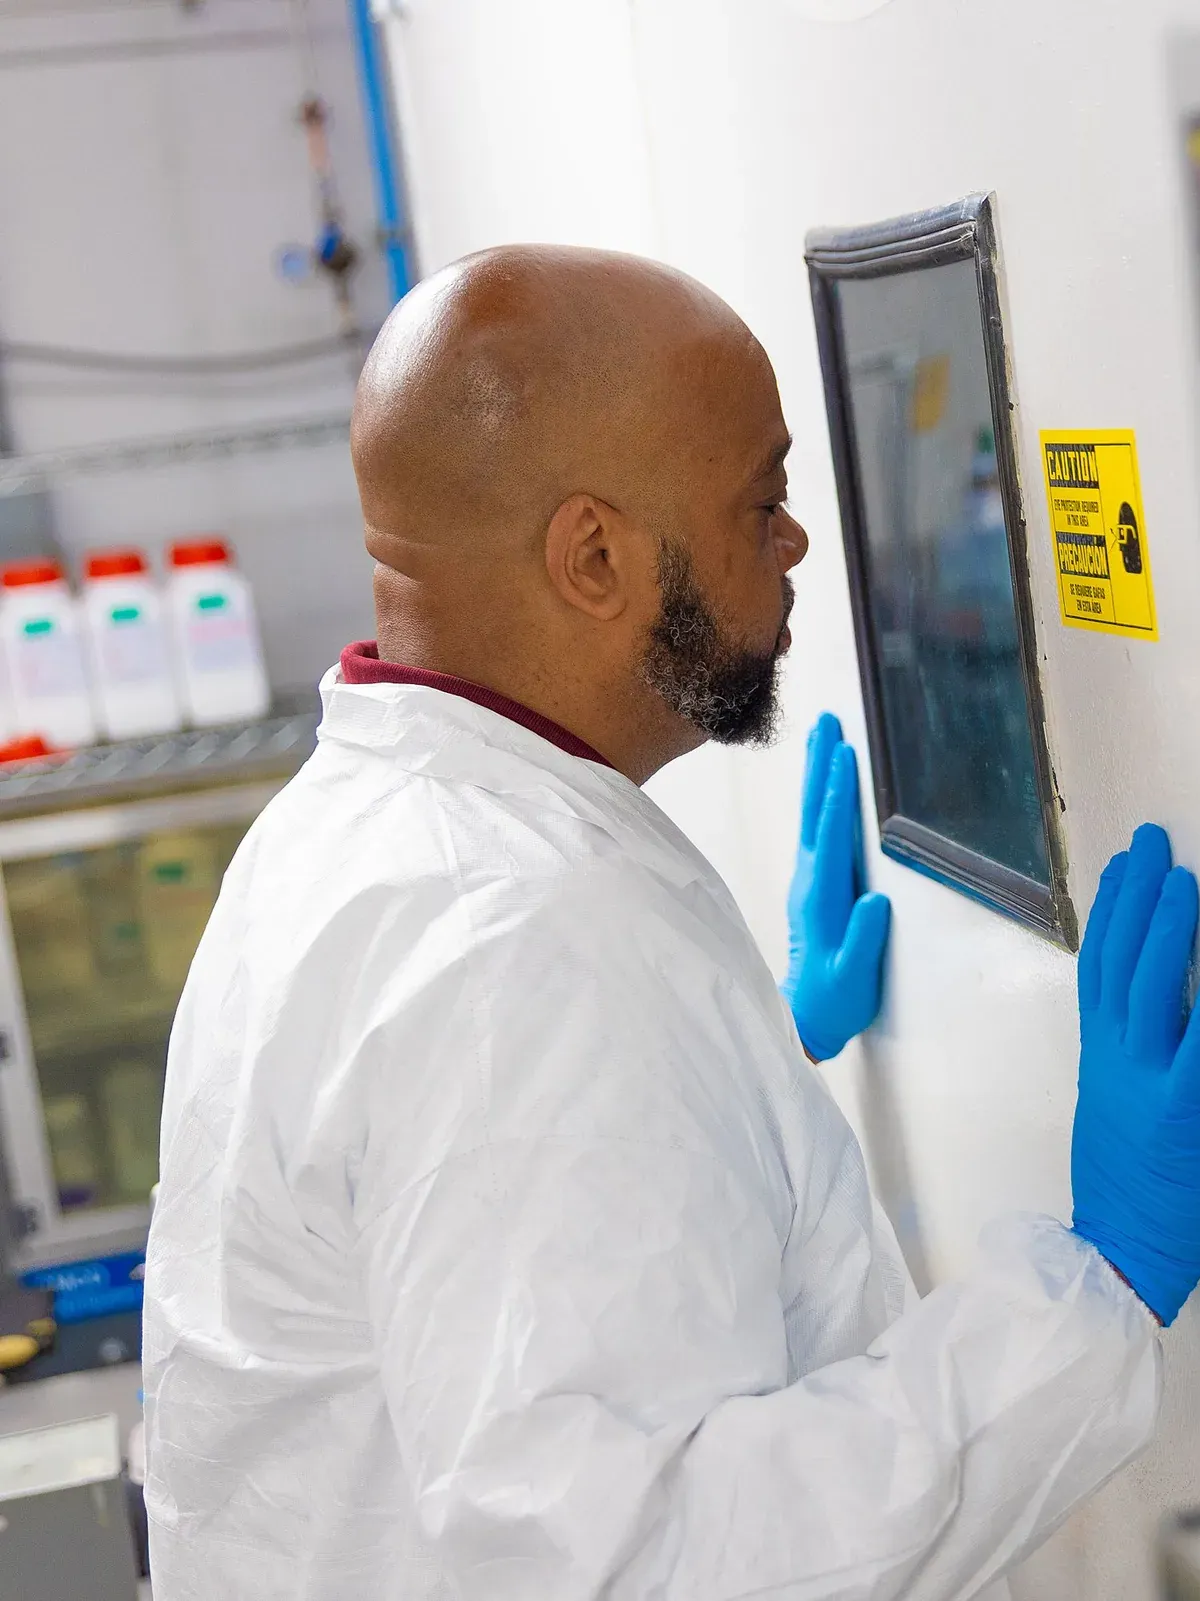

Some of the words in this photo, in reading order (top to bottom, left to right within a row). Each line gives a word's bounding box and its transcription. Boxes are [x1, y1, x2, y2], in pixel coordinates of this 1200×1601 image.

[1047, 451, 1098, 482] CAUTION
[1053, 499, 1061, 511] EYE
[1061, 499, 1081, 512] PROTECTION
[1081, 500, 1099, 514] REQUIRED
[1066, 514, 1071, 526] IN
[1071, 514, 1080, 527] THIS
[1080, 515, 1089, 528] AREA
[1070, 583, 1076, 596] SE
[1075, 583, 1092, 598] REQUIERE
[1092, 586, 1106, 600] GAFAS
[1076, 599, 1082, 611] EN
[1082, 600, 1092, 613] ESTA
